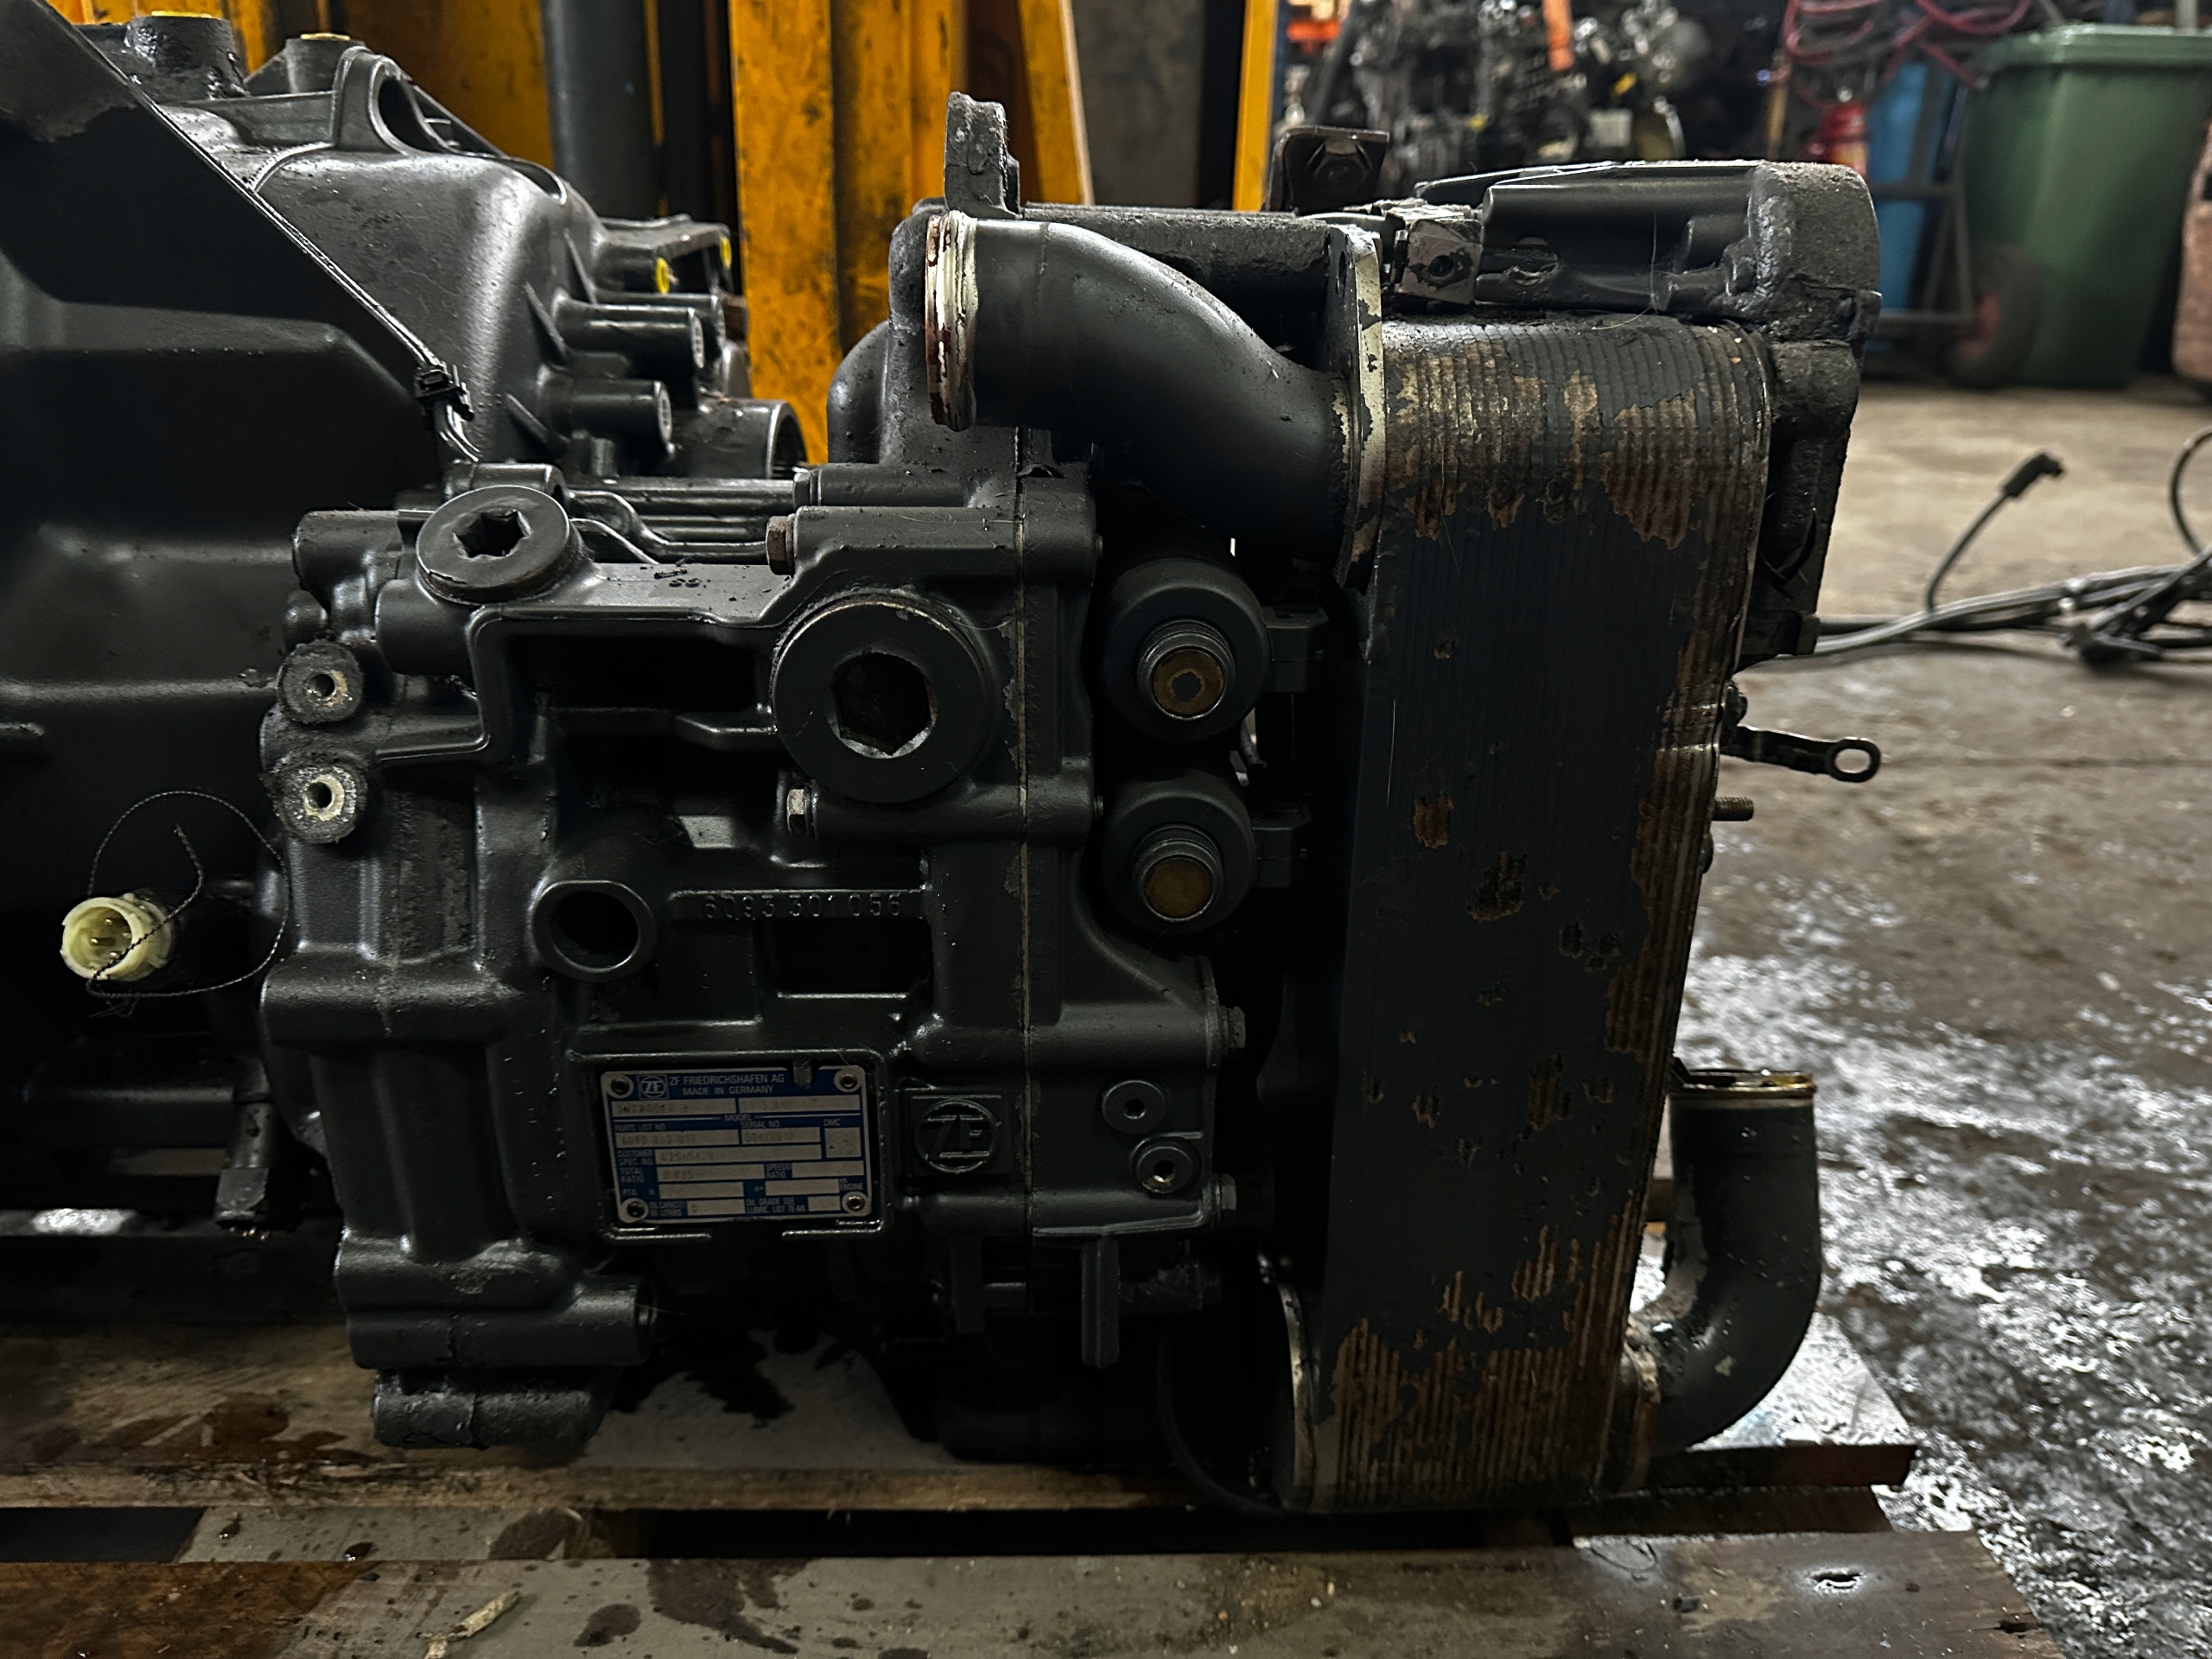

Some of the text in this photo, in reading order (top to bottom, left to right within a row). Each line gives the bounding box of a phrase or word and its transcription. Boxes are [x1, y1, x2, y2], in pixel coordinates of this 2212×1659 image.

[789, 894, 836, 918] 301
[849, 893, 901, 917] 056
[670, 1073, 785, 1085] ZF FRIEDRICHSHAFEN AG
[683, 1087, 710, 1096] MADE
[729, 1085, 773, 1095] GERMANY
[724, 1114, 753, 1122] MODEL
[823, 1118, 841, 1127] DMC
[925, 1113, 987, 1160] ZF
[618, 1149, 653, 1158] CUSTOMER
[841, 1183, 864, 1192] ENGINE
[660, 1200, 685, 1209] CAPACITY
